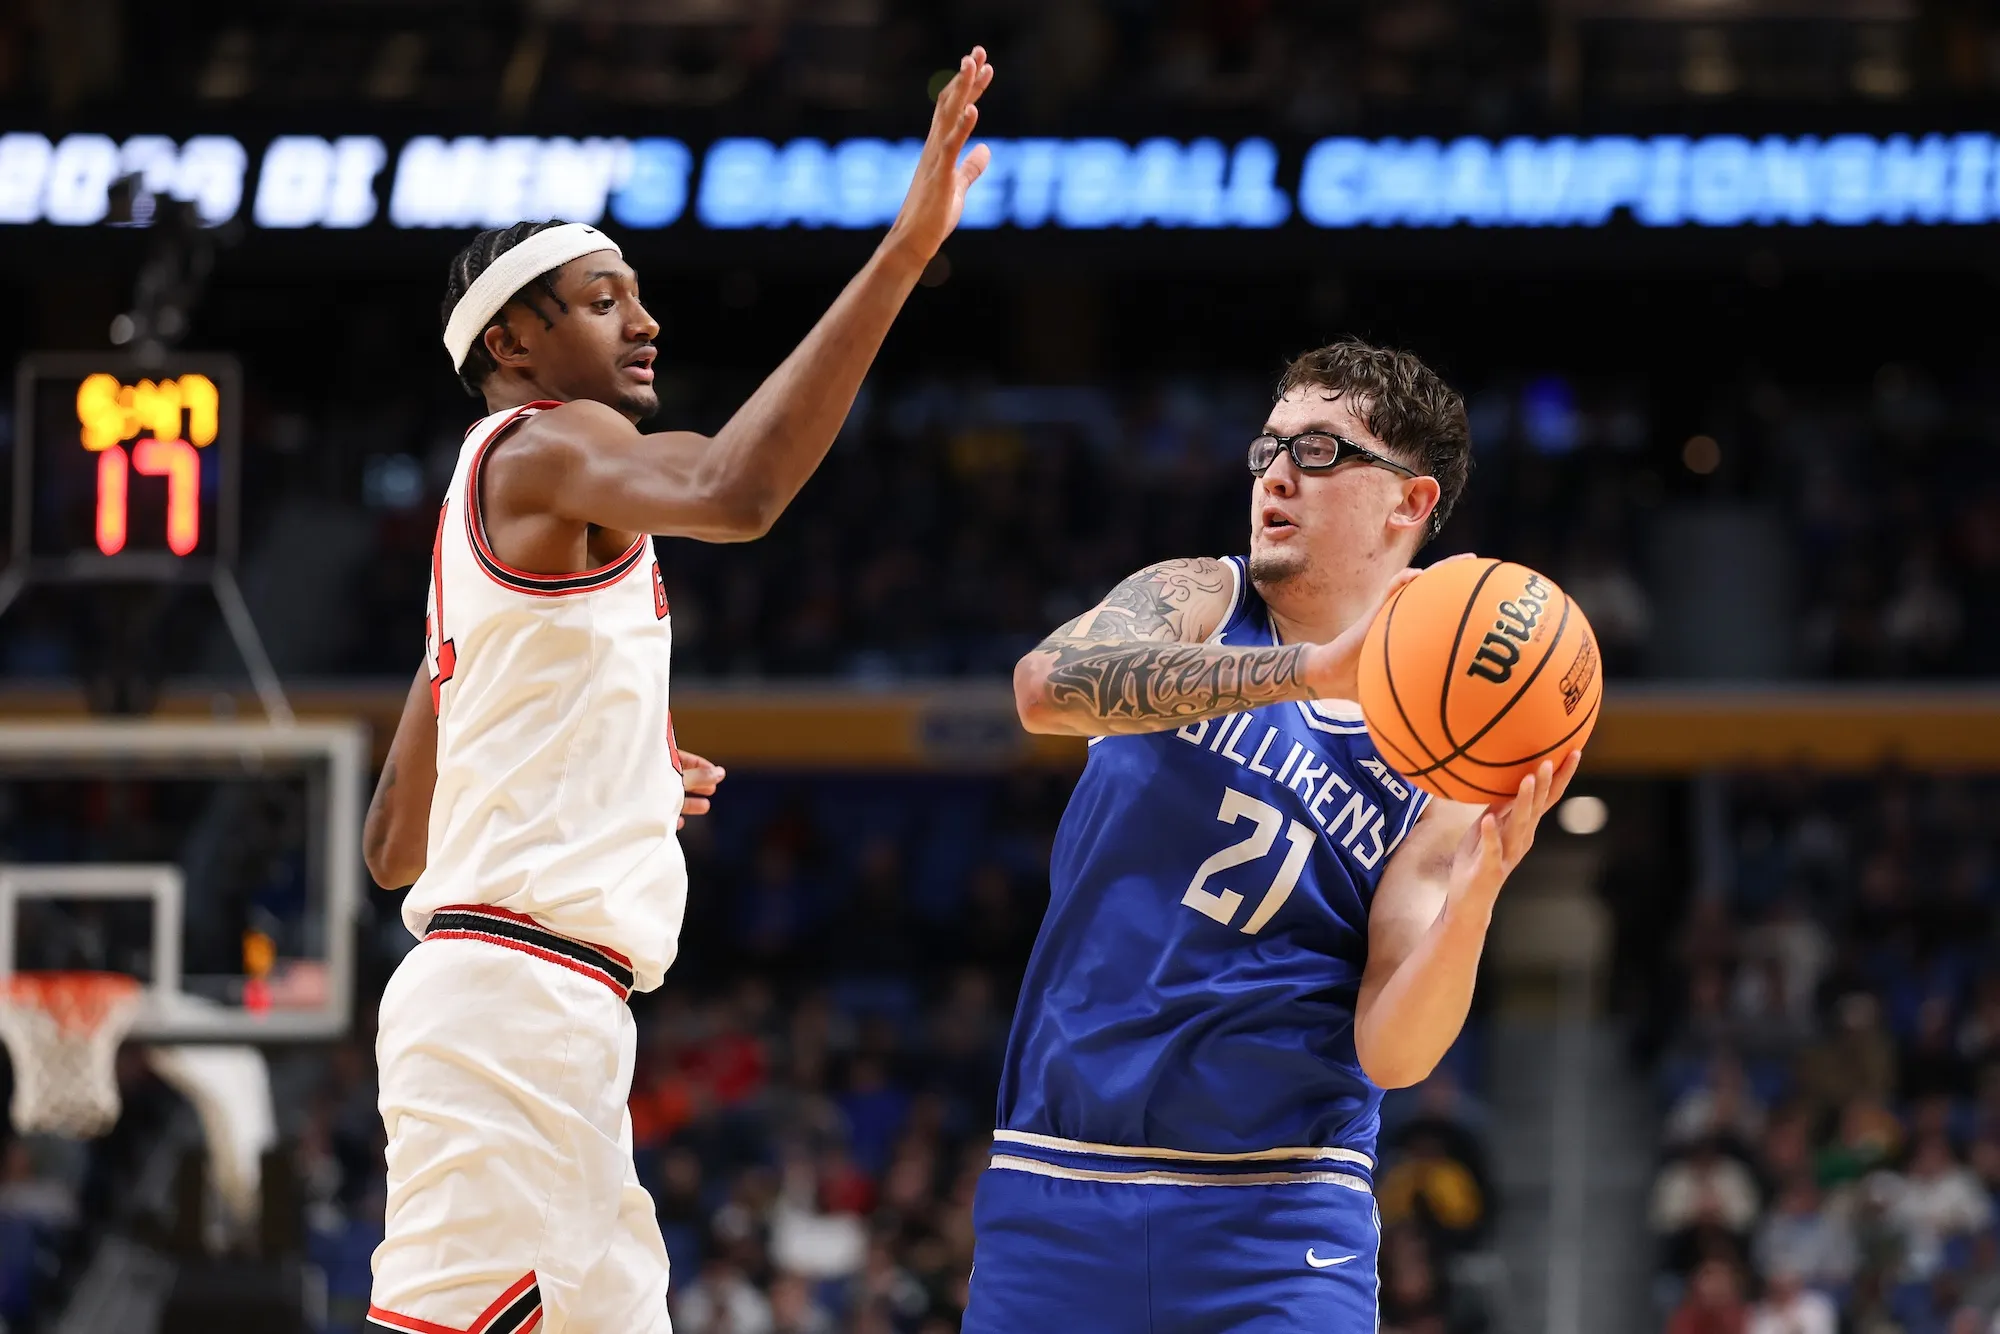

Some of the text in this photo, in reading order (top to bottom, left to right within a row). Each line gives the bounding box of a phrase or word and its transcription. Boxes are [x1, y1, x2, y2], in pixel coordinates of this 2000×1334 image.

[388, 135, 693, 229] MEN'S
[1300, 134, 2000, 228] CHAMPIONSHI
[96, 438, 200, 556] 17
[1357, 756, 1410, 801] A10
[1181, 786, 1317, 935] 21
